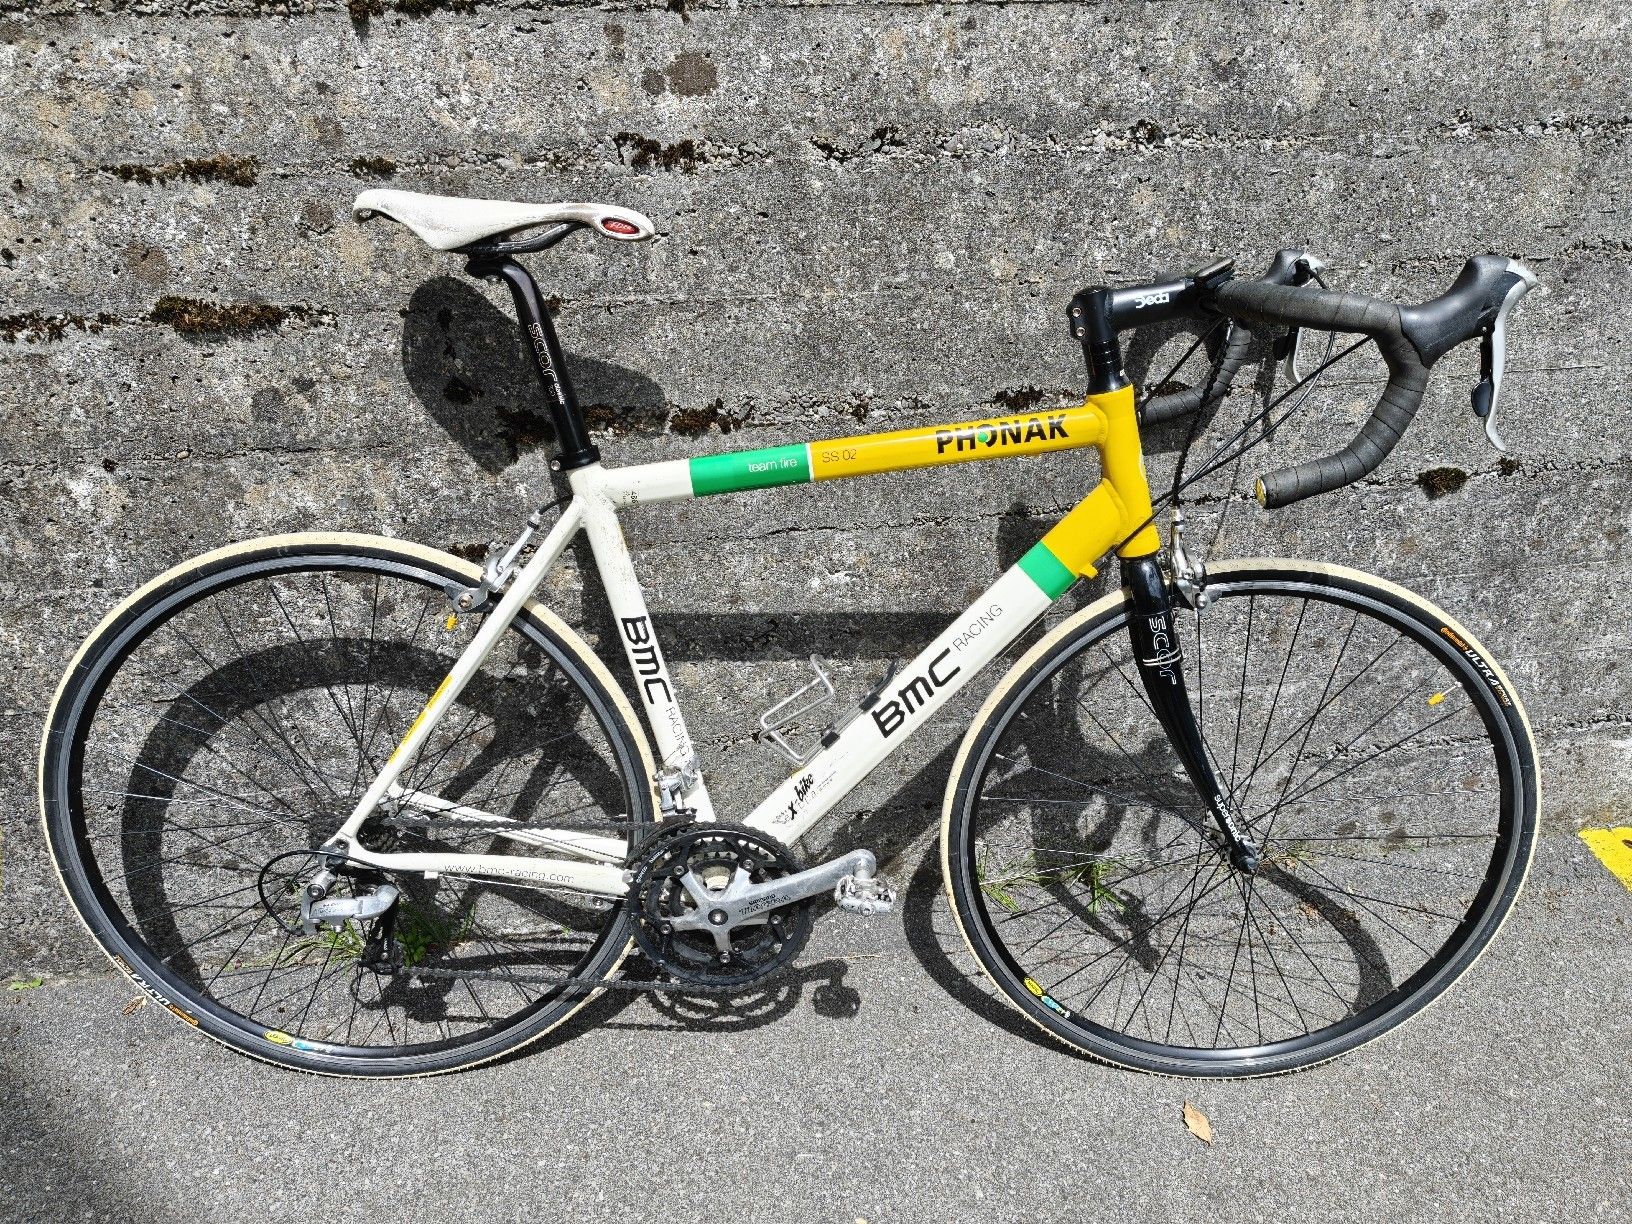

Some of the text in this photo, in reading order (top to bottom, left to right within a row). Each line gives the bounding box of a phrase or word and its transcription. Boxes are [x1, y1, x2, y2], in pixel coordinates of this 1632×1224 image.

[1135, 292, 1169, 309] Deda
[936, 413, 1069, 454] PHONAK
[748, 460, 778, 473] team
[822, 449, 856, 463] SS 02
[871, 603, 1004, 739] BMC RACING
[1464, 649, 1500, 686] ULTRA
[620, 615, 690, 757] BMC RACING
[444, 864, 575, 884] www.bmc-racing.com
[131, 973, 171, 1006] ULTRA
